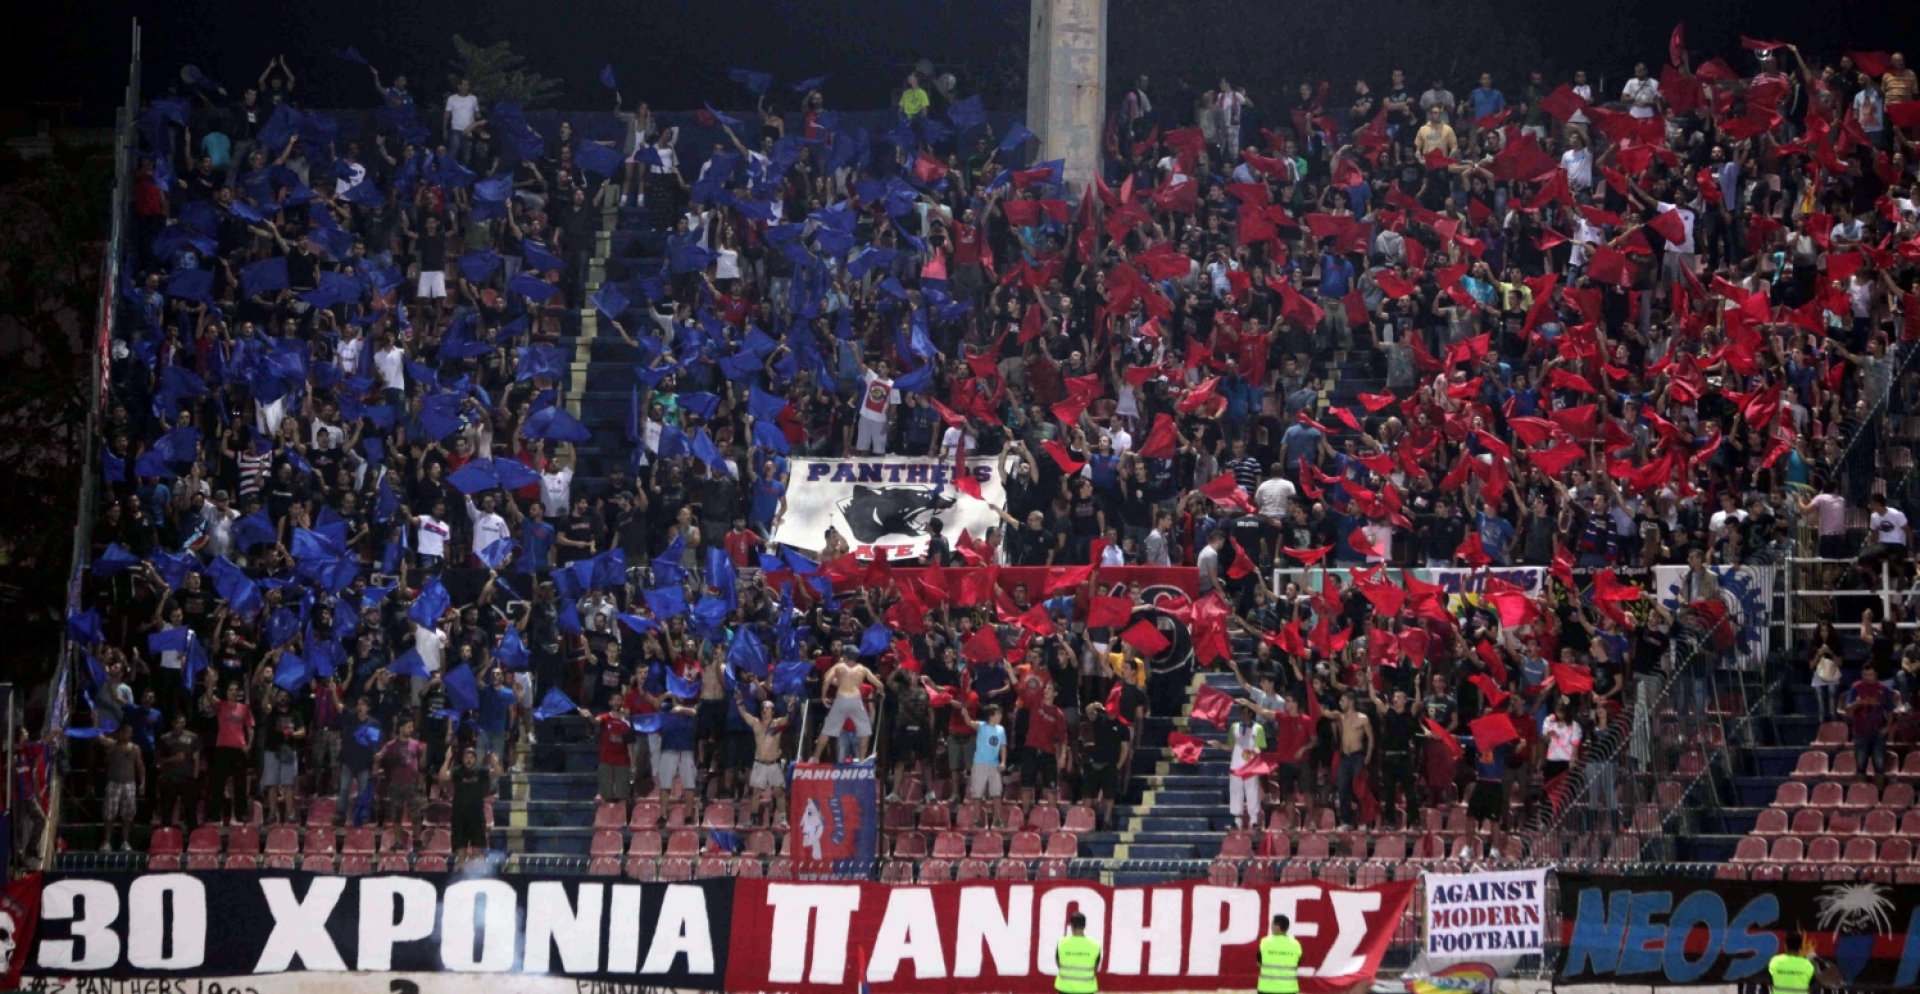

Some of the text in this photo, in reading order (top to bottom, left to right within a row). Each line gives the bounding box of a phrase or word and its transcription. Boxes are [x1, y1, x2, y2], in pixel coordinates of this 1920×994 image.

[792, 768, 875, 780] PANIONIOS
[1432, 880, 1537, 903] AGAINST
[37, 873, 207, 971] 30
[253, 875, 715, 974] ΧΡΟΝΙΑ
[1431, 904, 1539, 931] MODERN
[1429, 930, 1543, 954] FOOTBALL
[1563, 888, 1780, 982] NEOS
